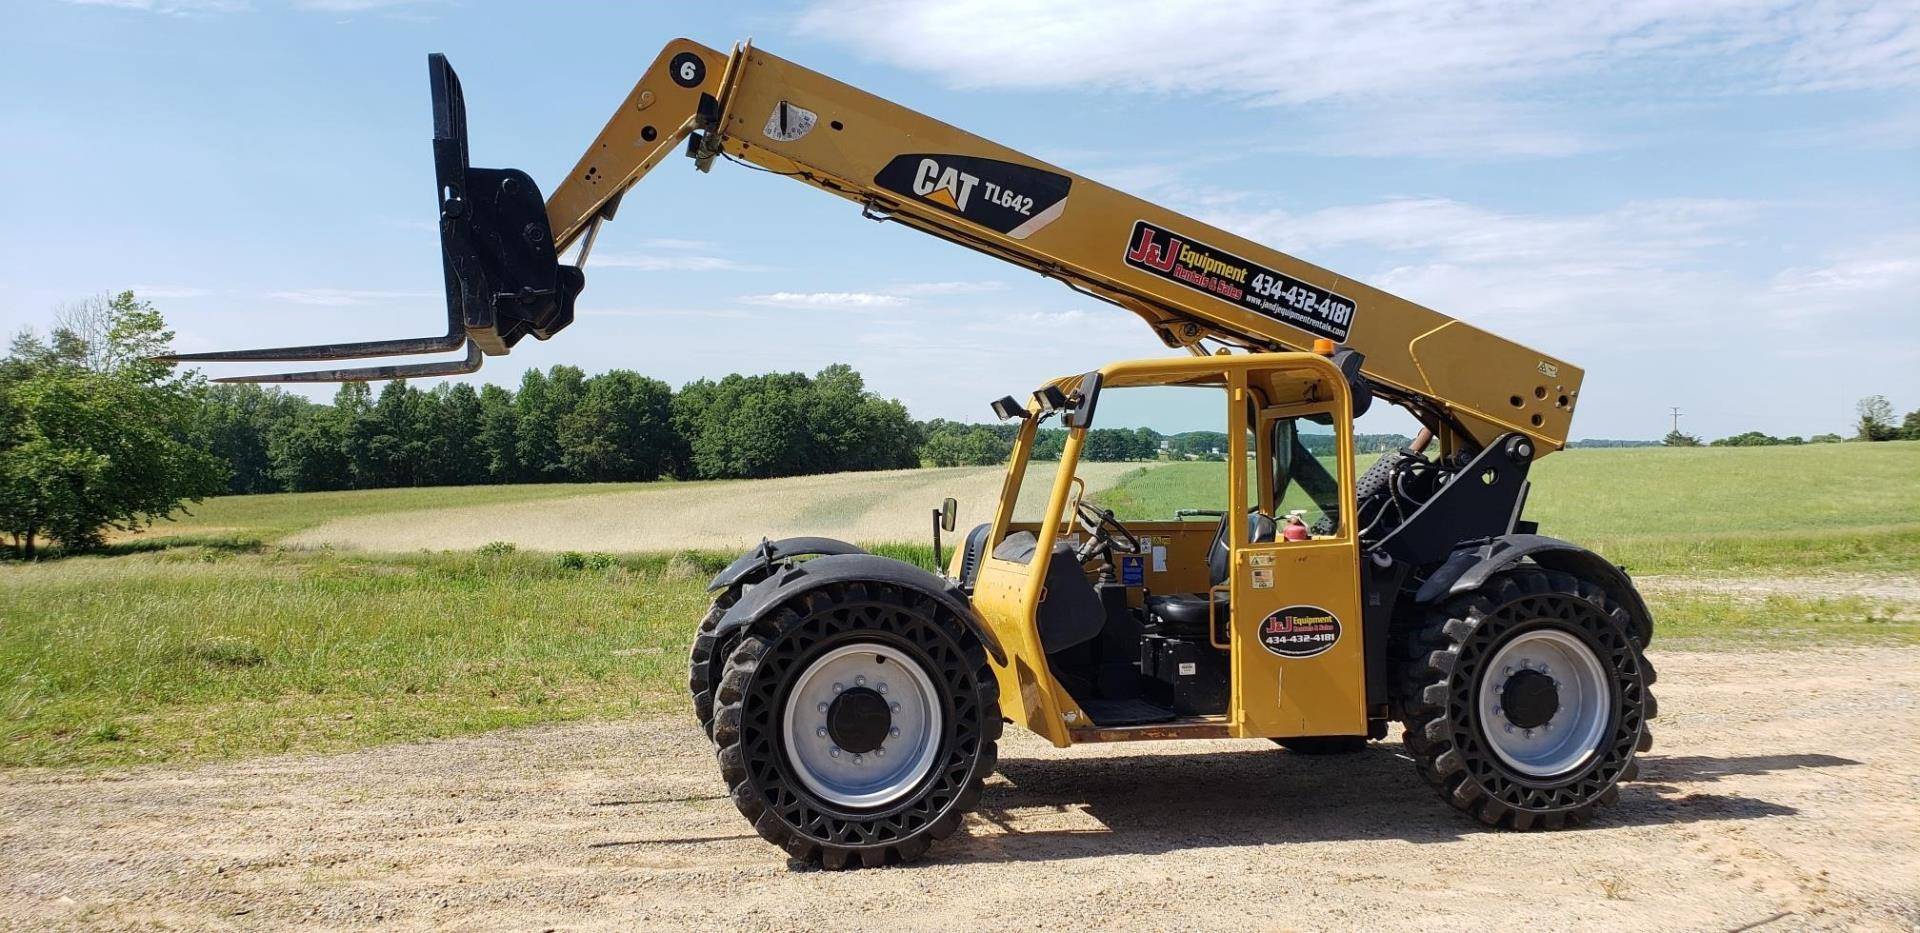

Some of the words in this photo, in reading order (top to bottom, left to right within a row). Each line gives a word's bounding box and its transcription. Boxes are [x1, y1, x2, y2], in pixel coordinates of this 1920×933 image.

[680, 61, 696, 81] 6
[912, 158, 980, 213] CAT
[984, 181, 1034, 216] TL642
[1129, 227, 1182, 272] J&J
[1179, 244, 1248, 284] Equipment
[1173, 263, 1210, 287] Rentals
[1217, 279, 1242, 301] Sales
[1251, 273, 1352, 326] 434-432-4181
[1246, 294, 1346, 337] www.jandjequipmentrentals.com
[1266, 633, 1335, 644] 434-432-4181
[1293, 616, 1333, 626] Equipment
